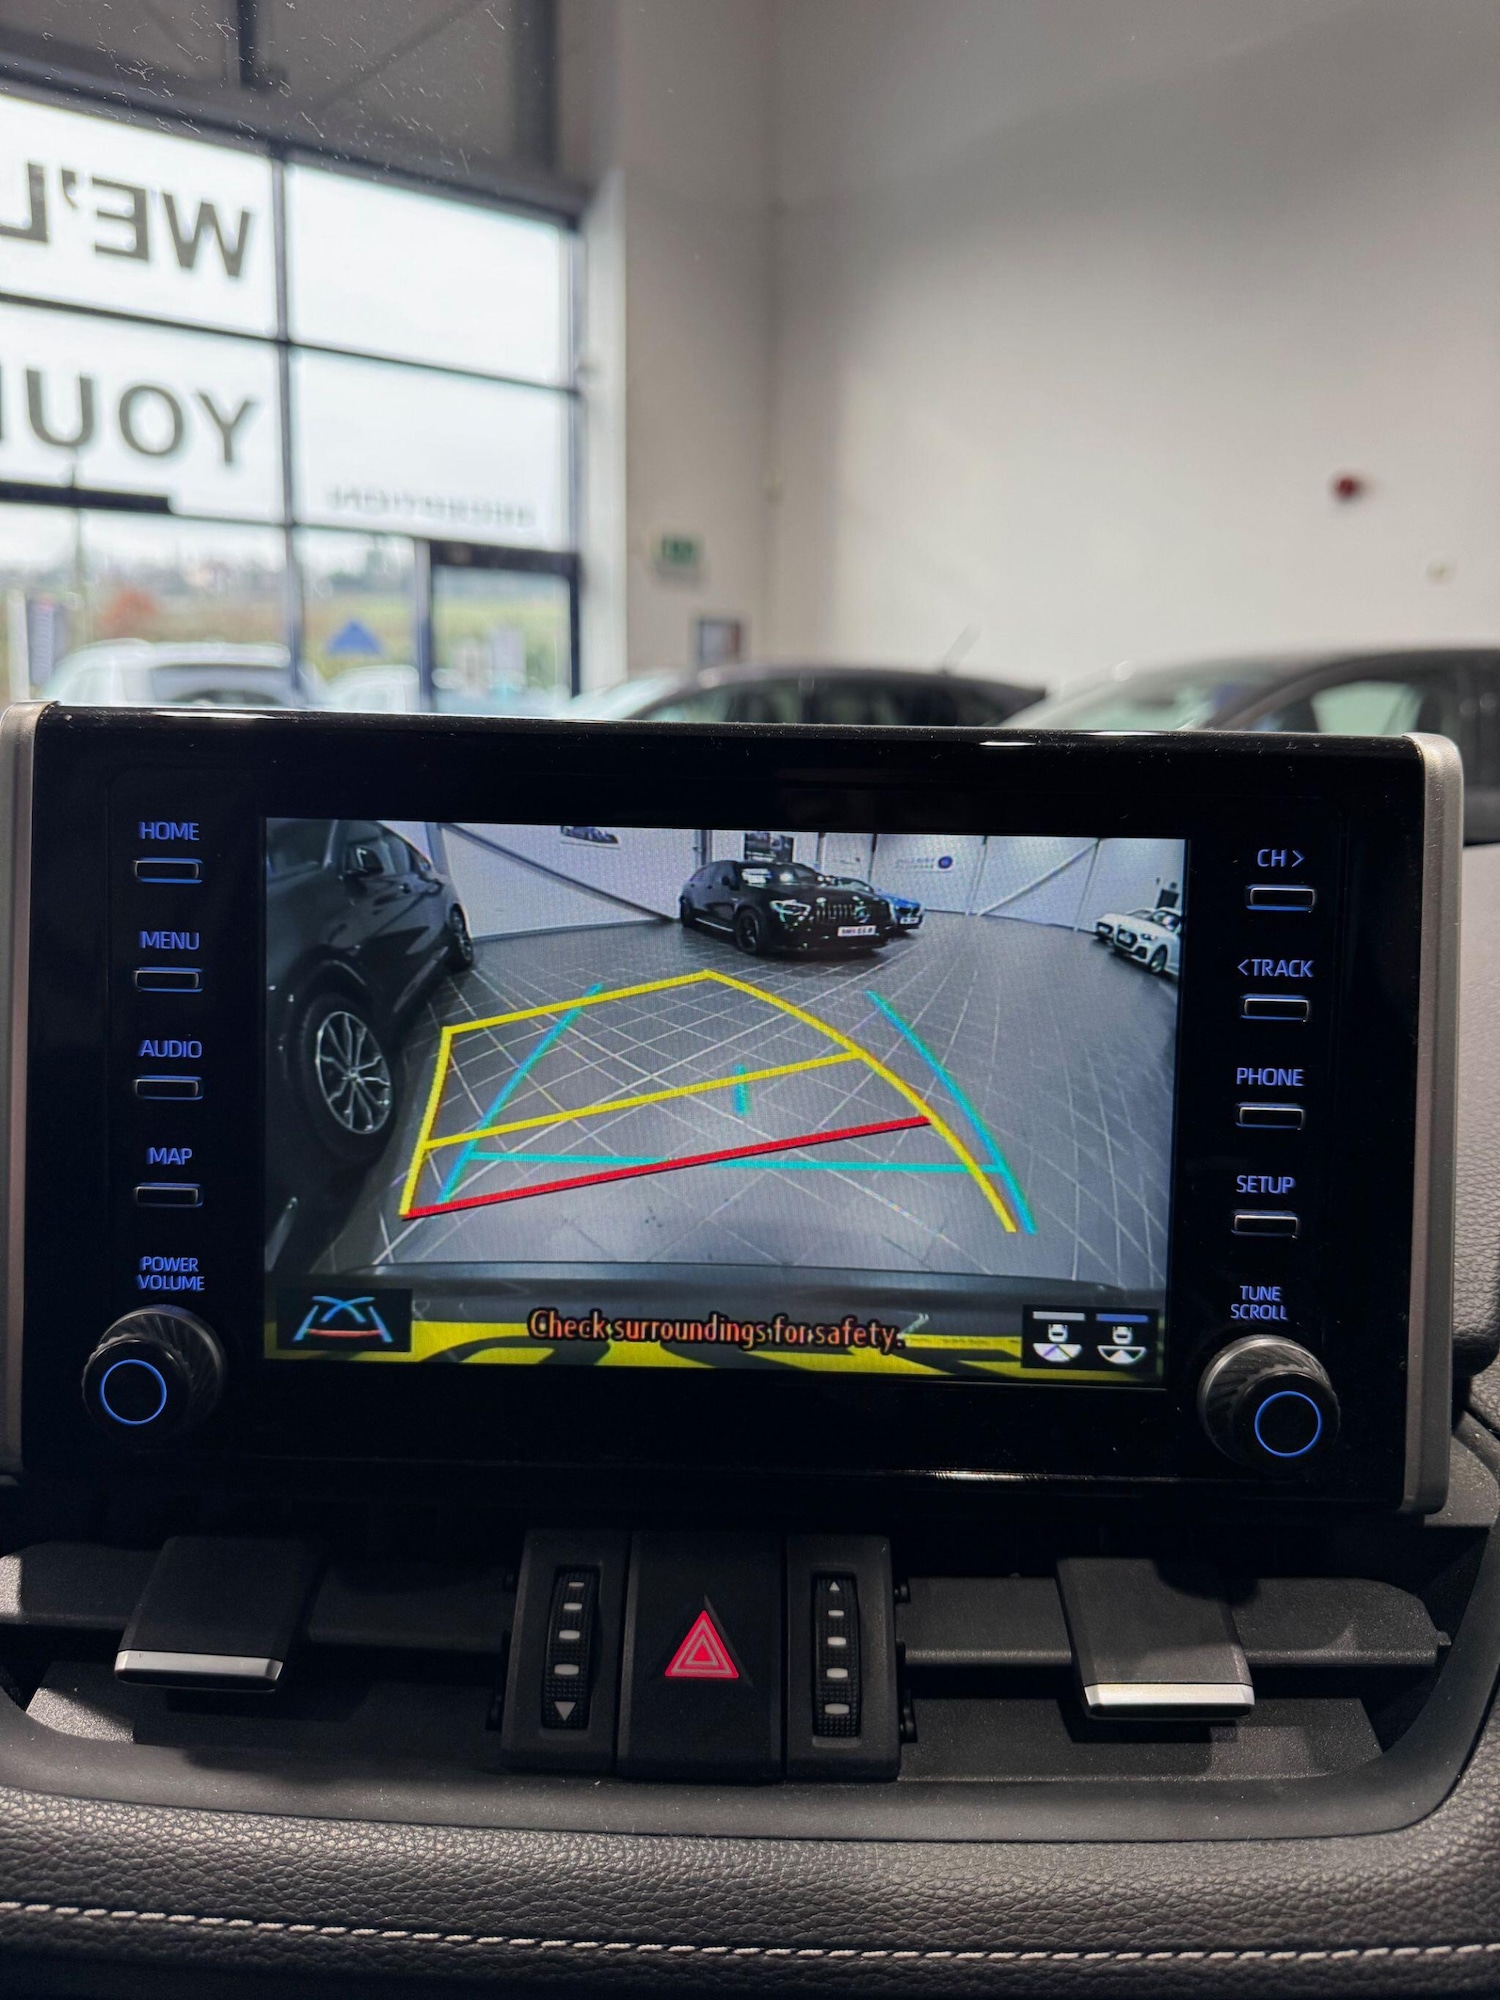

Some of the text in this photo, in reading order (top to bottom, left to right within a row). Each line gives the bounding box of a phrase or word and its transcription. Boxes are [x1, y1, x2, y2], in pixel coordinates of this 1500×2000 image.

[139, 822, 199, 841] HOME
[1257, 849, 1286, 867] CH
[140, 931, 200, 950] MENU
[1252, 959, 1313, 978] TRACK
[140, 1039, 202, 1059] AUDIO
[1236, 1067, 1304, 1087] PHONE
[147, 1147, 193, 1165] MAP
[1236, 1175, 1295, 1194] SETUP
[141, 1256, 199, 1272] POWER
[137, 1275, 205, 1291] VOLUME
[1240, 1285, 1282, 1301] TUNE
[1230, 1303, 1288, 1320] SCROLL
[530, 1309, 904, 1353] Check surroundings for safety.
